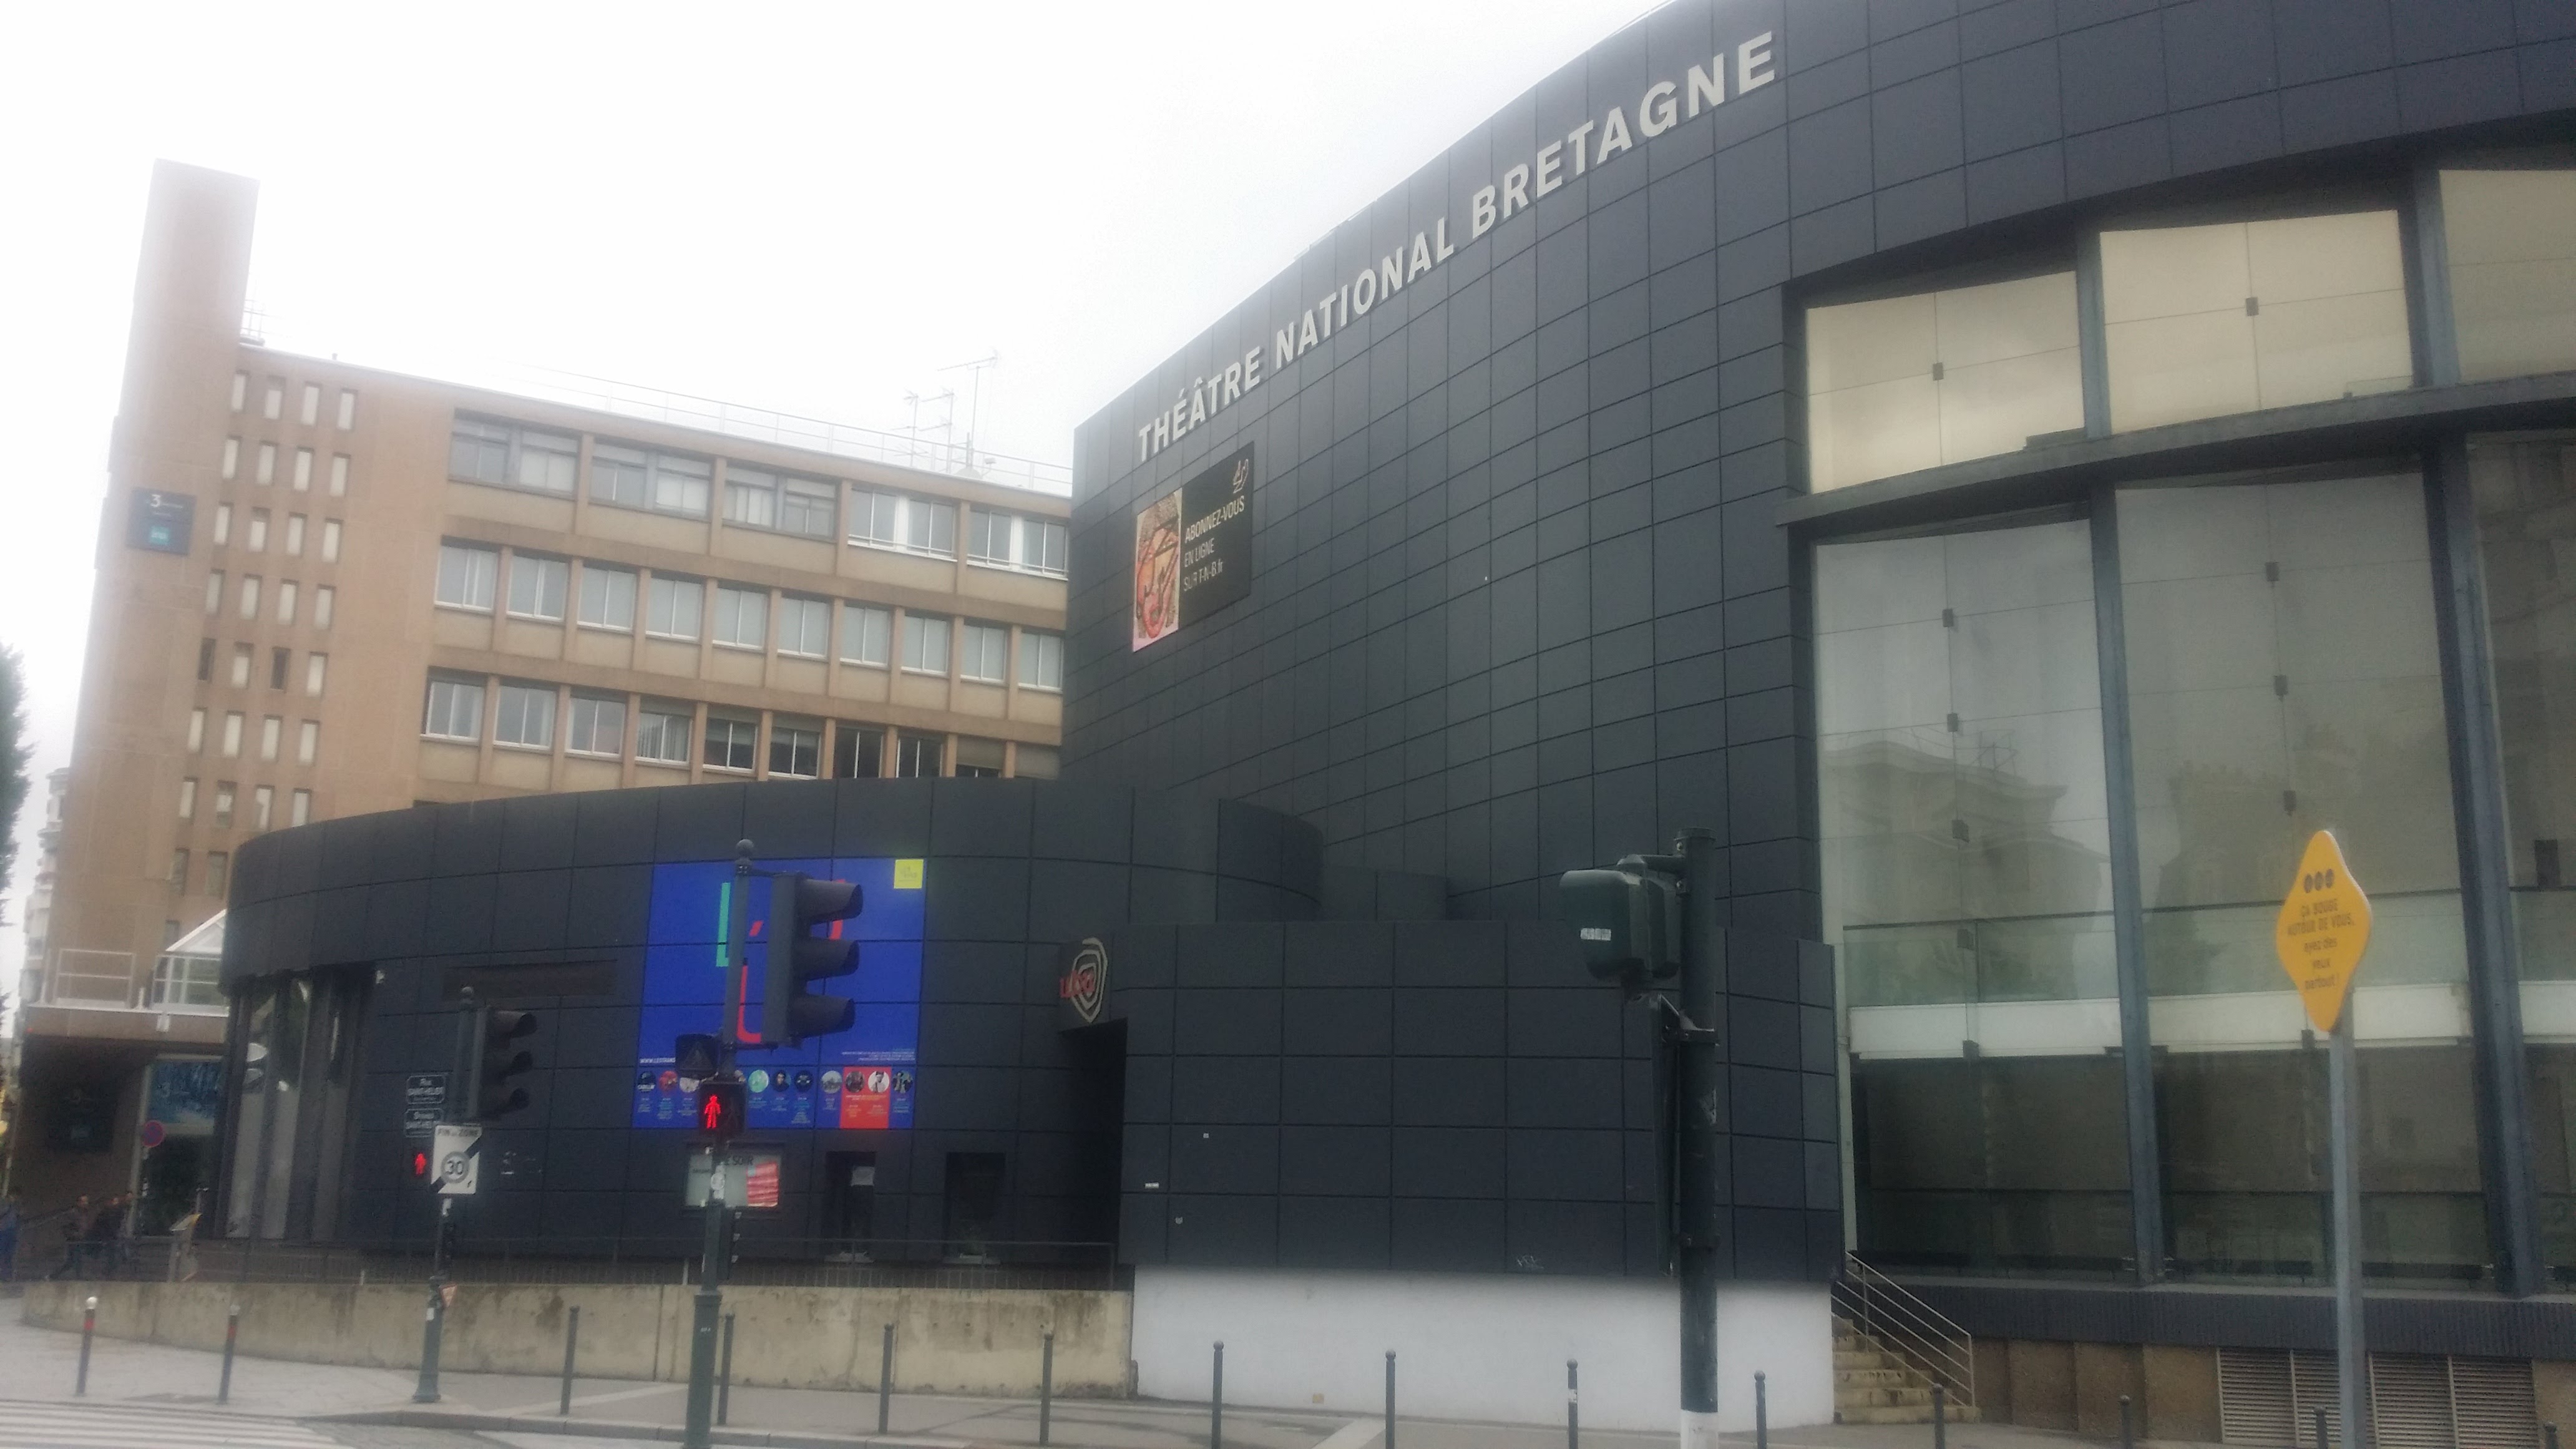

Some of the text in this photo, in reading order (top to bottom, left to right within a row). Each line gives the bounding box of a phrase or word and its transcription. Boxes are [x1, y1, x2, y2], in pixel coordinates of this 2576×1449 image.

[1138, 31, 1776, 462] THÉÂTRE NATIONAL BRETAGNE
[150, 494, 161, 508] 3
[1184, 495, 1245, 543] ABONNEZ-VOUS
[1184, 537, 1215, 568] EN LIGNE
[1183, 571, 1197, 592] SUR
[2318, 917, 2328, 931] DE
[446, 1159, 464, 1175] 30
